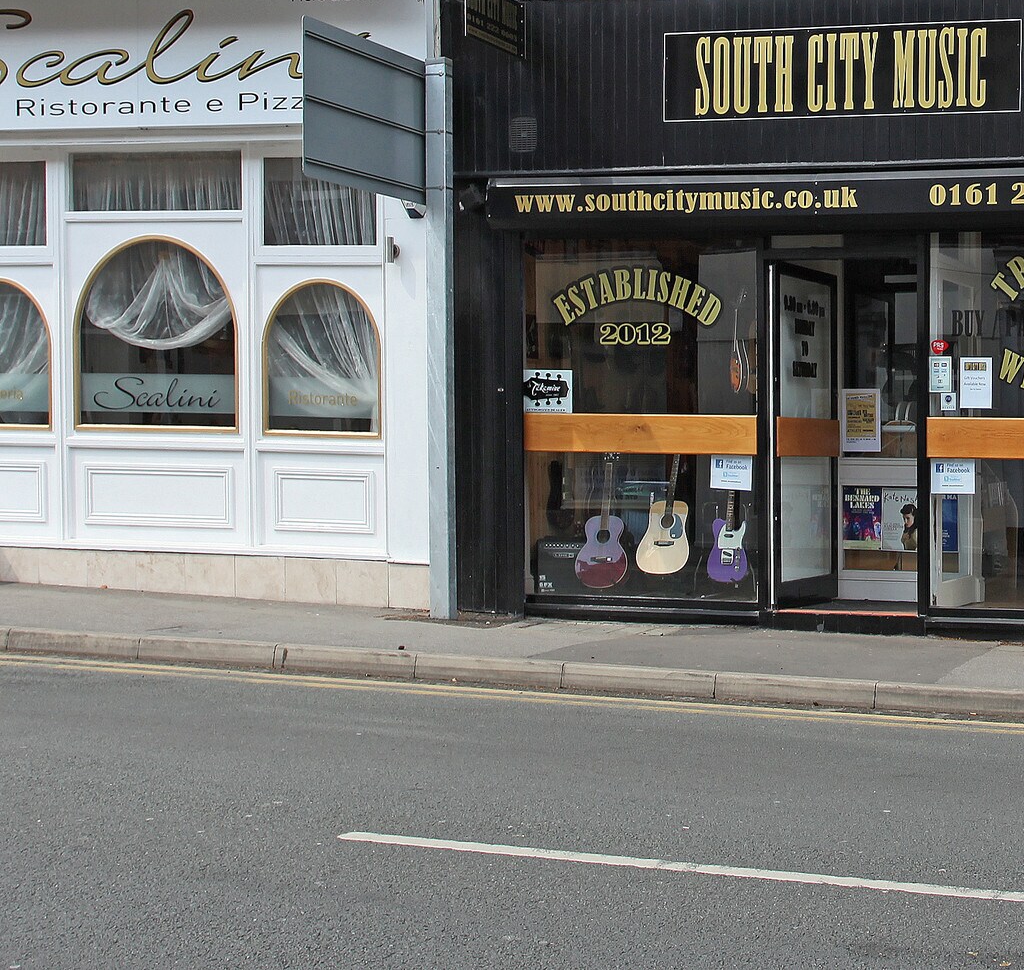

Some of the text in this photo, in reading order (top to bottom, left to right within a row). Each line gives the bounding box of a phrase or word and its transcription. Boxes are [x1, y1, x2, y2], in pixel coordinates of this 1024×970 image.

[0, 9, 372, 88] calin
[695, 26, 988, 116] SOUTH CITY MUSIC
[16, 92, 304, 117] Ristorante e Pizz
[515, 186, 858, 214] www.southcitymusic.co.uk
[929, 182, 998, 207] 0161
[553, 268, 722, 326] ESTABLISHED
[600, 323, 671, 345] 2012
[952, 309, 985, 337] BUY
[94, 376, 222, 410] Scalini
[288, 390, 358, 407] Ristorante
[849, 501, 875, 509] LAKES
[883, 492, 899, 504] Kate
